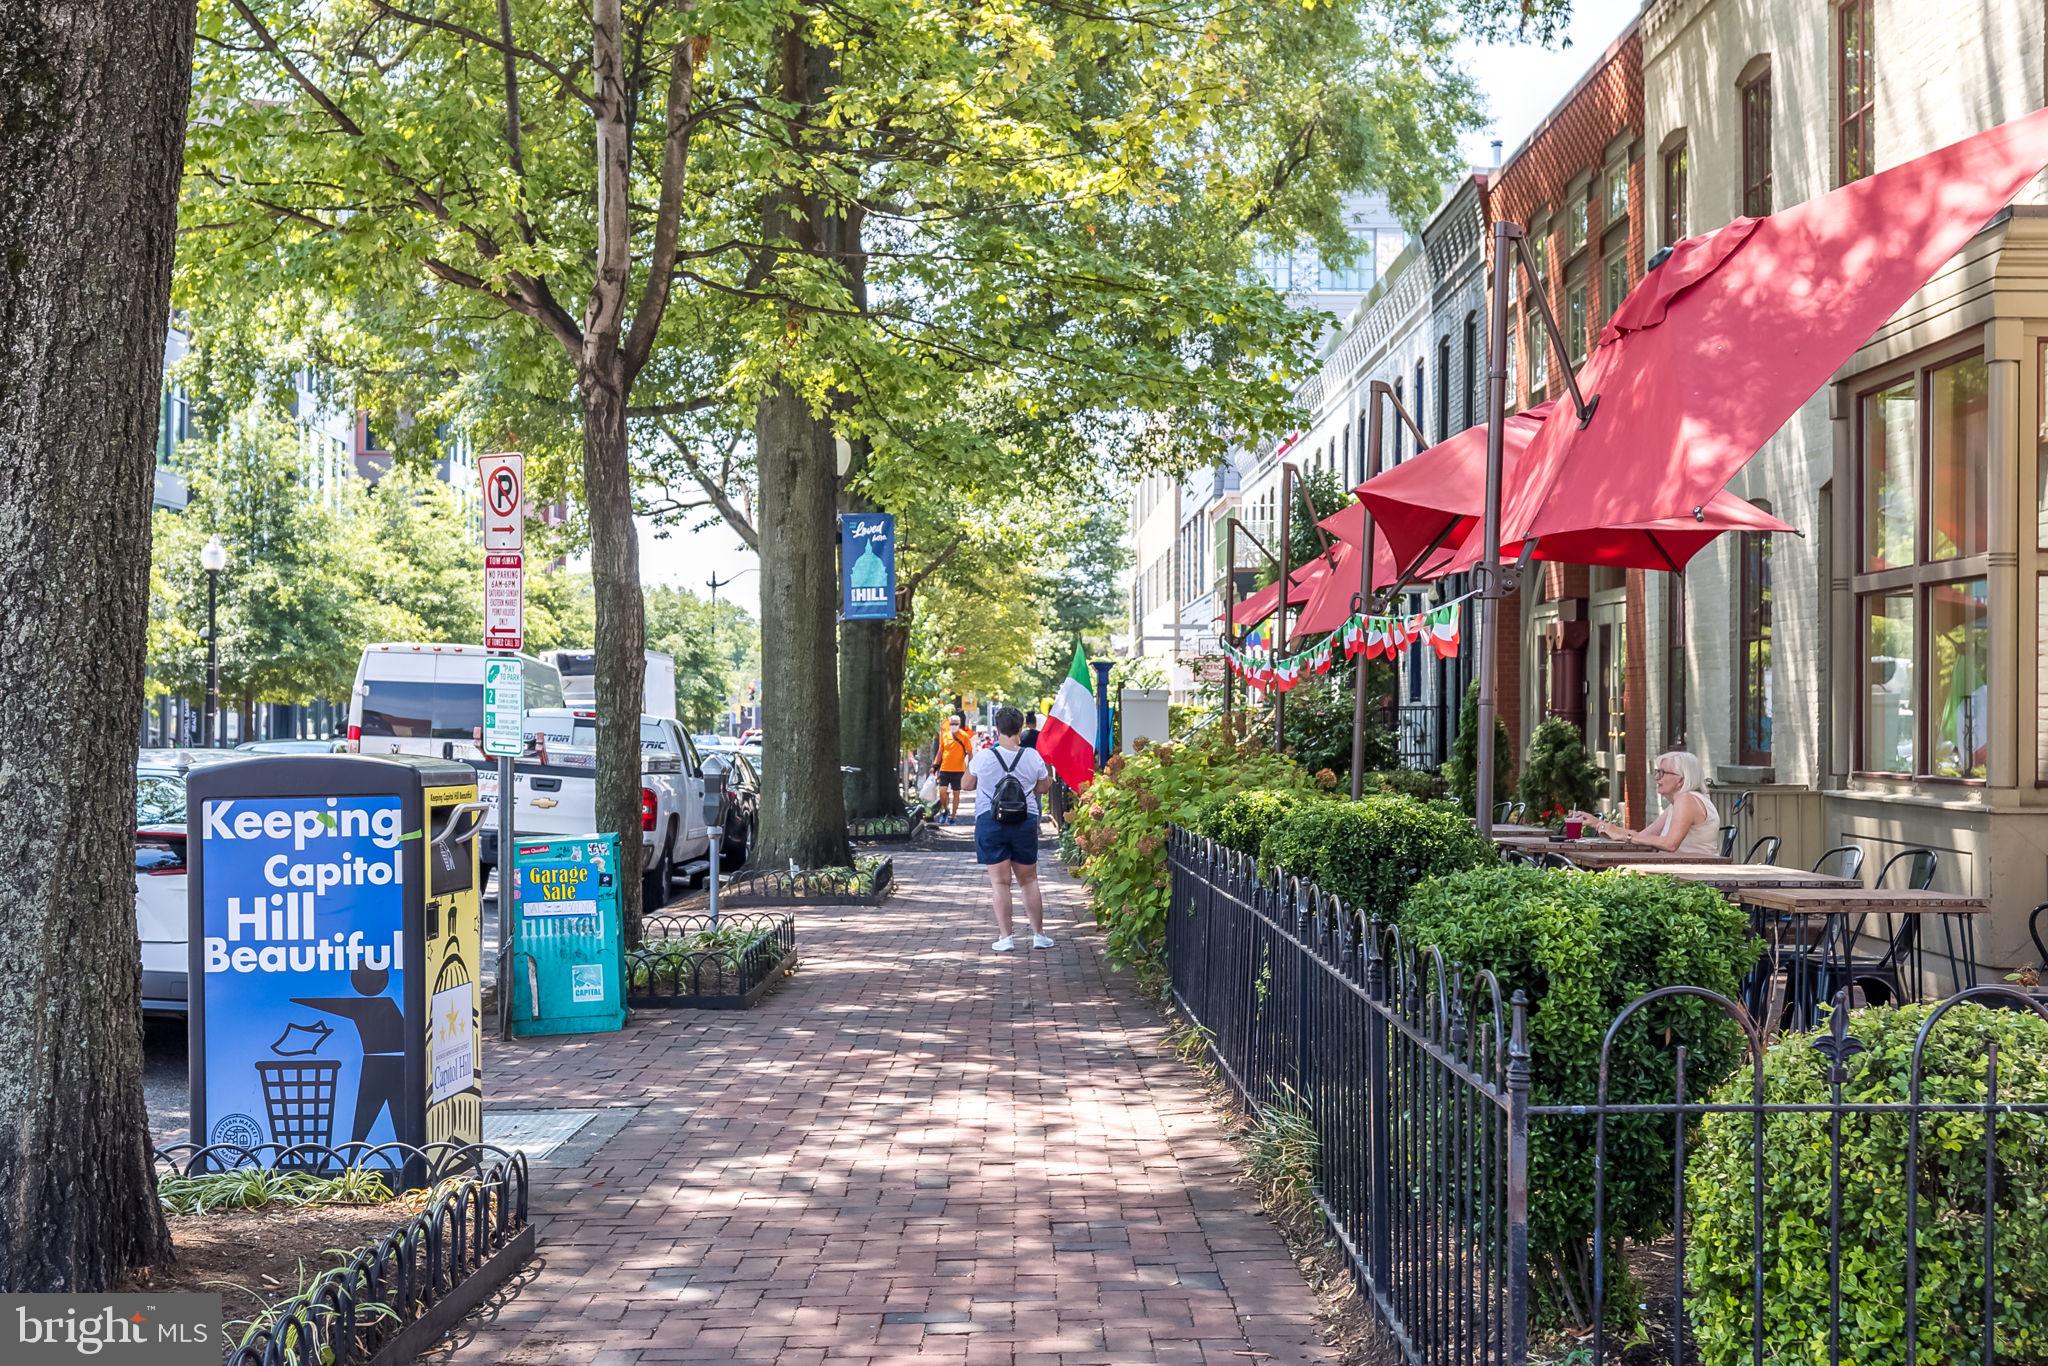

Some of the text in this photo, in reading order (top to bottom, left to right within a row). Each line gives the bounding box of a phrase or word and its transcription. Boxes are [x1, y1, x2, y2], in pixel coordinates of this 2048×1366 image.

[852, 521, 884, 538] Loved
[489, 571, 518, 579] NO PARKING
[856, 588, 888, 601] HILL
[488, 690, 493, 703] 2
[202, 798, 402, 850] Keeping
[264, 850, 403, 896] Capitol
[529, 866, 588, 884] Garage
[542, 884, 576, 900] Sale
[228, 892, 315, 941] Hill
[204, 931, 404, 973] Beautiful
[575, 989, 601, 997] CAPITAL
[434, 1058, 458, 1092] Capitol
[459, 1052, 472, 1078] Hill
[216, 1119, 258, 1138] EASTERN MARKET
[220, 1150, 236, 1161] MAIN
